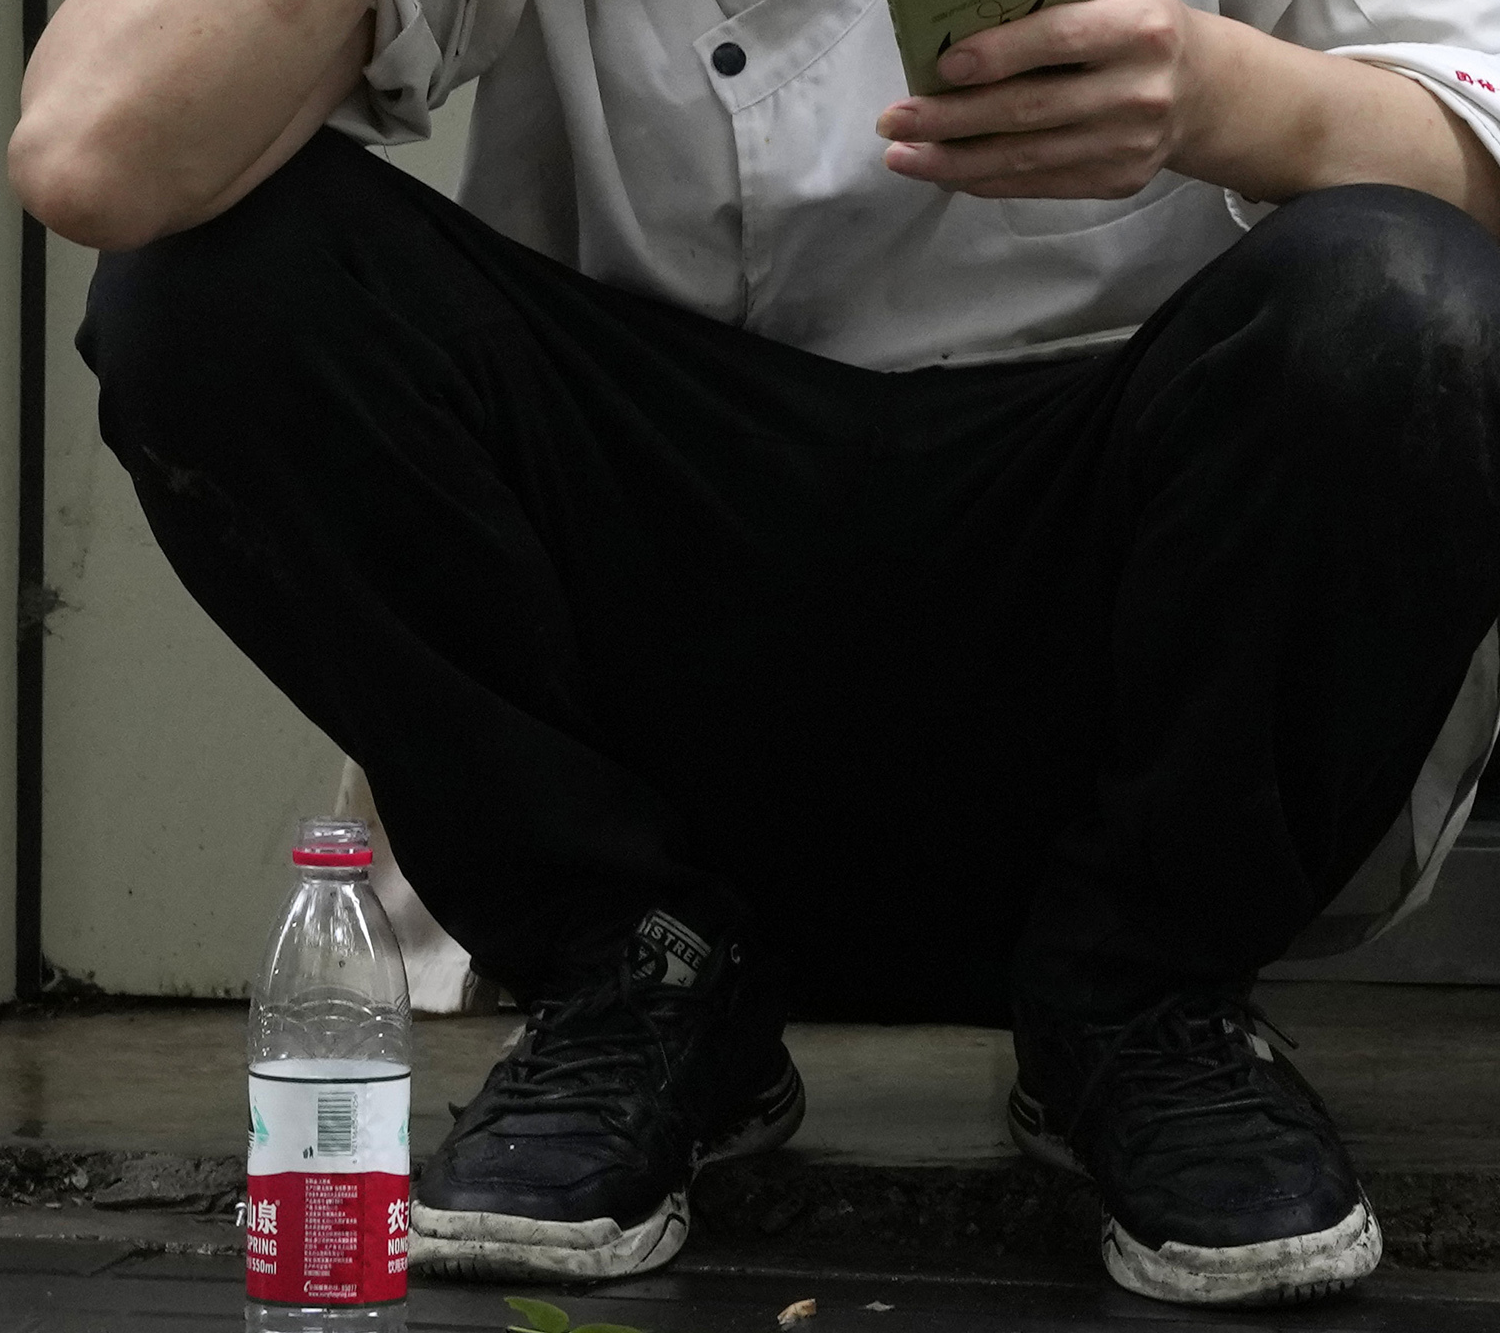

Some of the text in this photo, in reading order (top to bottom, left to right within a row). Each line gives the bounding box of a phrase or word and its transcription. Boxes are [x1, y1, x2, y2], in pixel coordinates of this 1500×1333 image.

[649, 923, 703, 972] STREE
[247, 1195, 278, 1235] 山泉
[247, 1233, 278, 1258] PRING
[252, 1256, 278, 1276] 550ml
